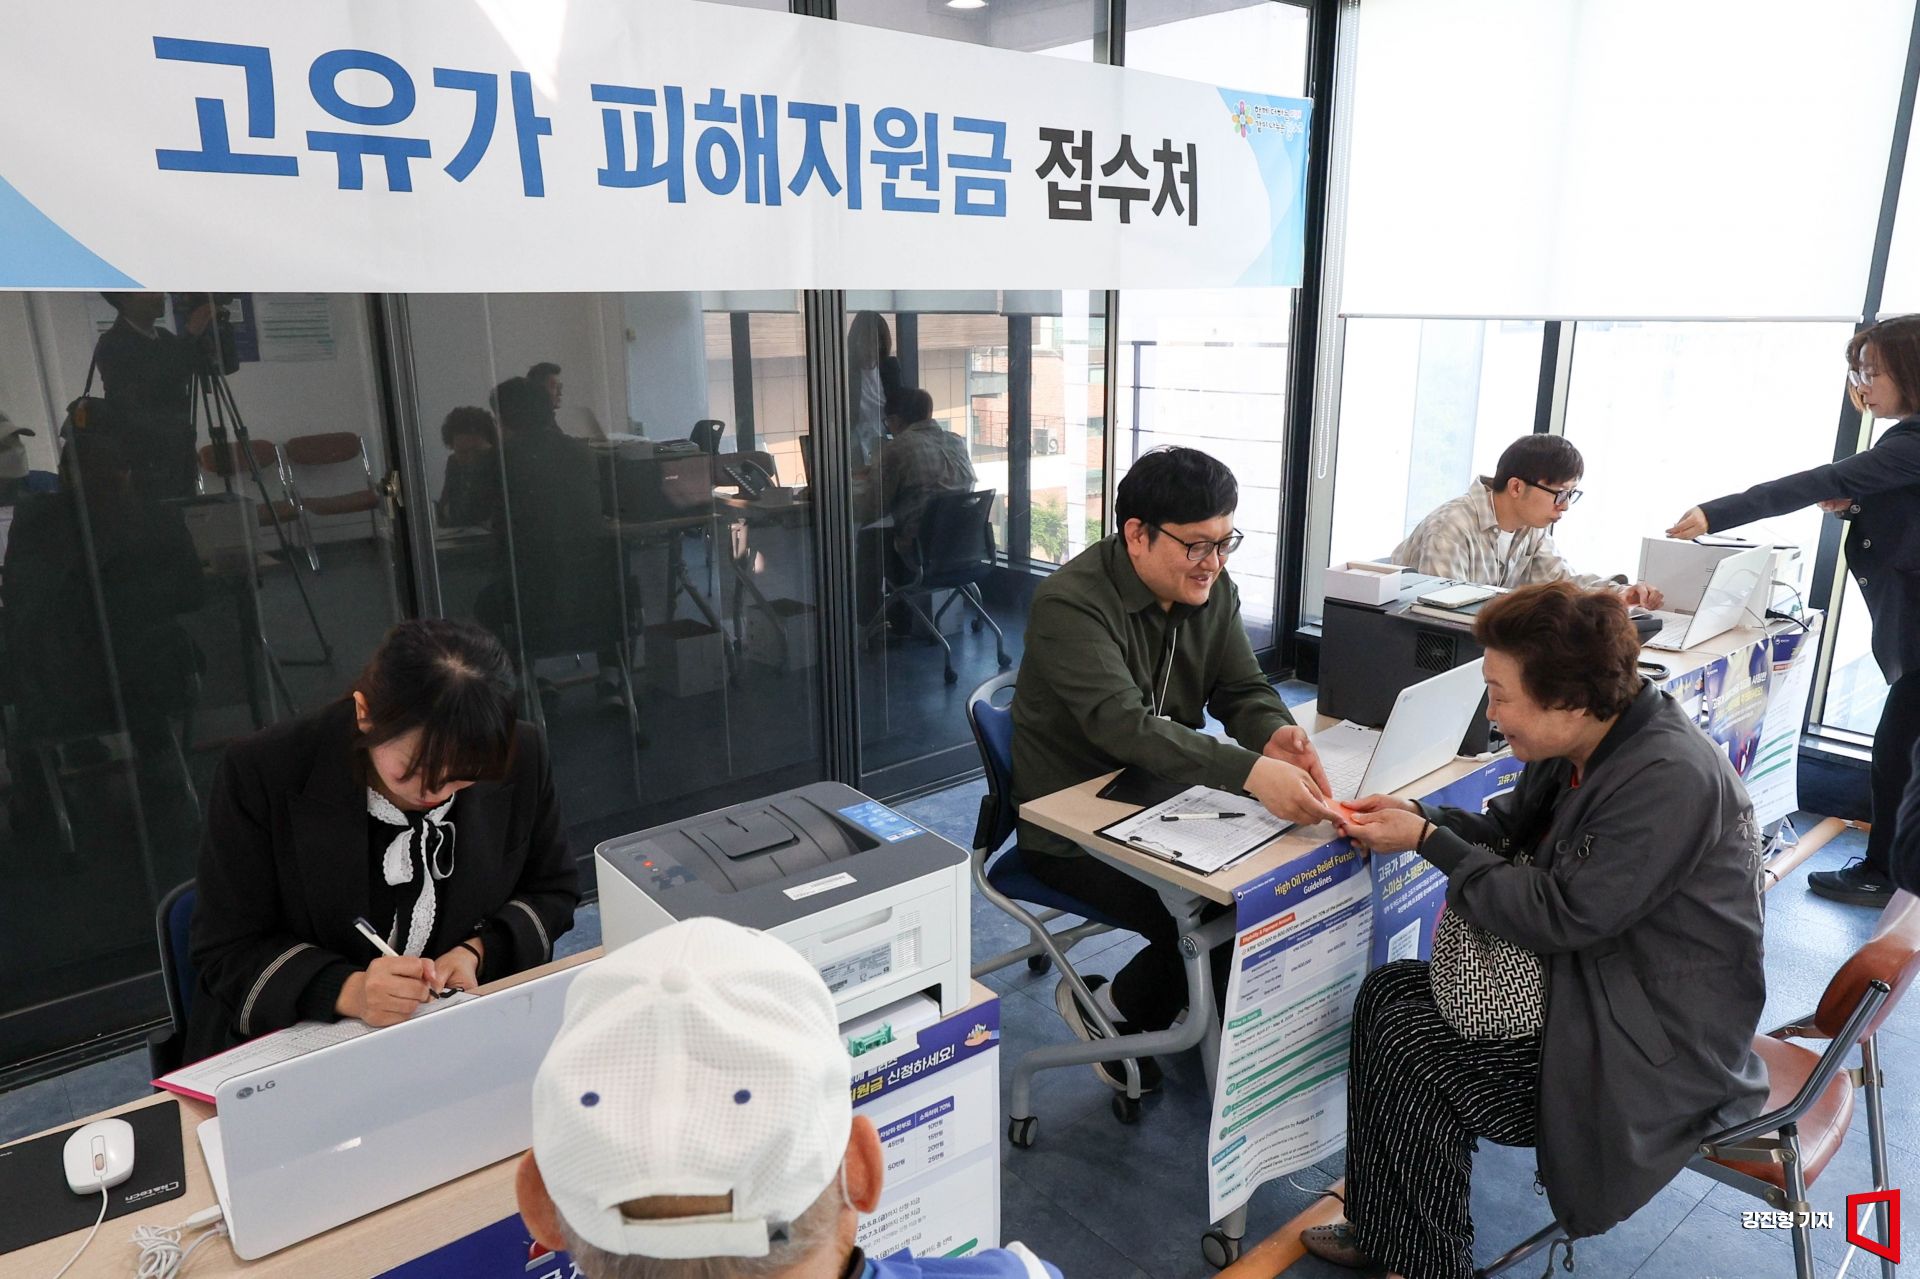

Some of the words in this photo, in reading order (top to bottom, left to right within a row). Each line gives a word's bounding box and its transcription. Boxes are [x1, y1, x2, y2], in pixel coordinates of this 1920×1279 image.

[152, 36, 554, 198] 고유가
[590, 83, 1013, 218] 피해지원금
[1034, 125, 1199, 227] 접수처
[1497, 773, 1517, 786] 고유가
[1274, 881, 1291, 896] High
[1291, 874, 1301, 887] Oil
[1301, 868, 1318, 883] Price
[1317, 856, 1335, 874] Relief
[1334, 850, 1356, 867] Funds
[1378, 857, 1399, 883] 고유가
[1303, 875, 1333, 895] Guidelines
[887, 1044, 955, 1086] 신청하세요!
[256, 1080, 276, 1092] LG
